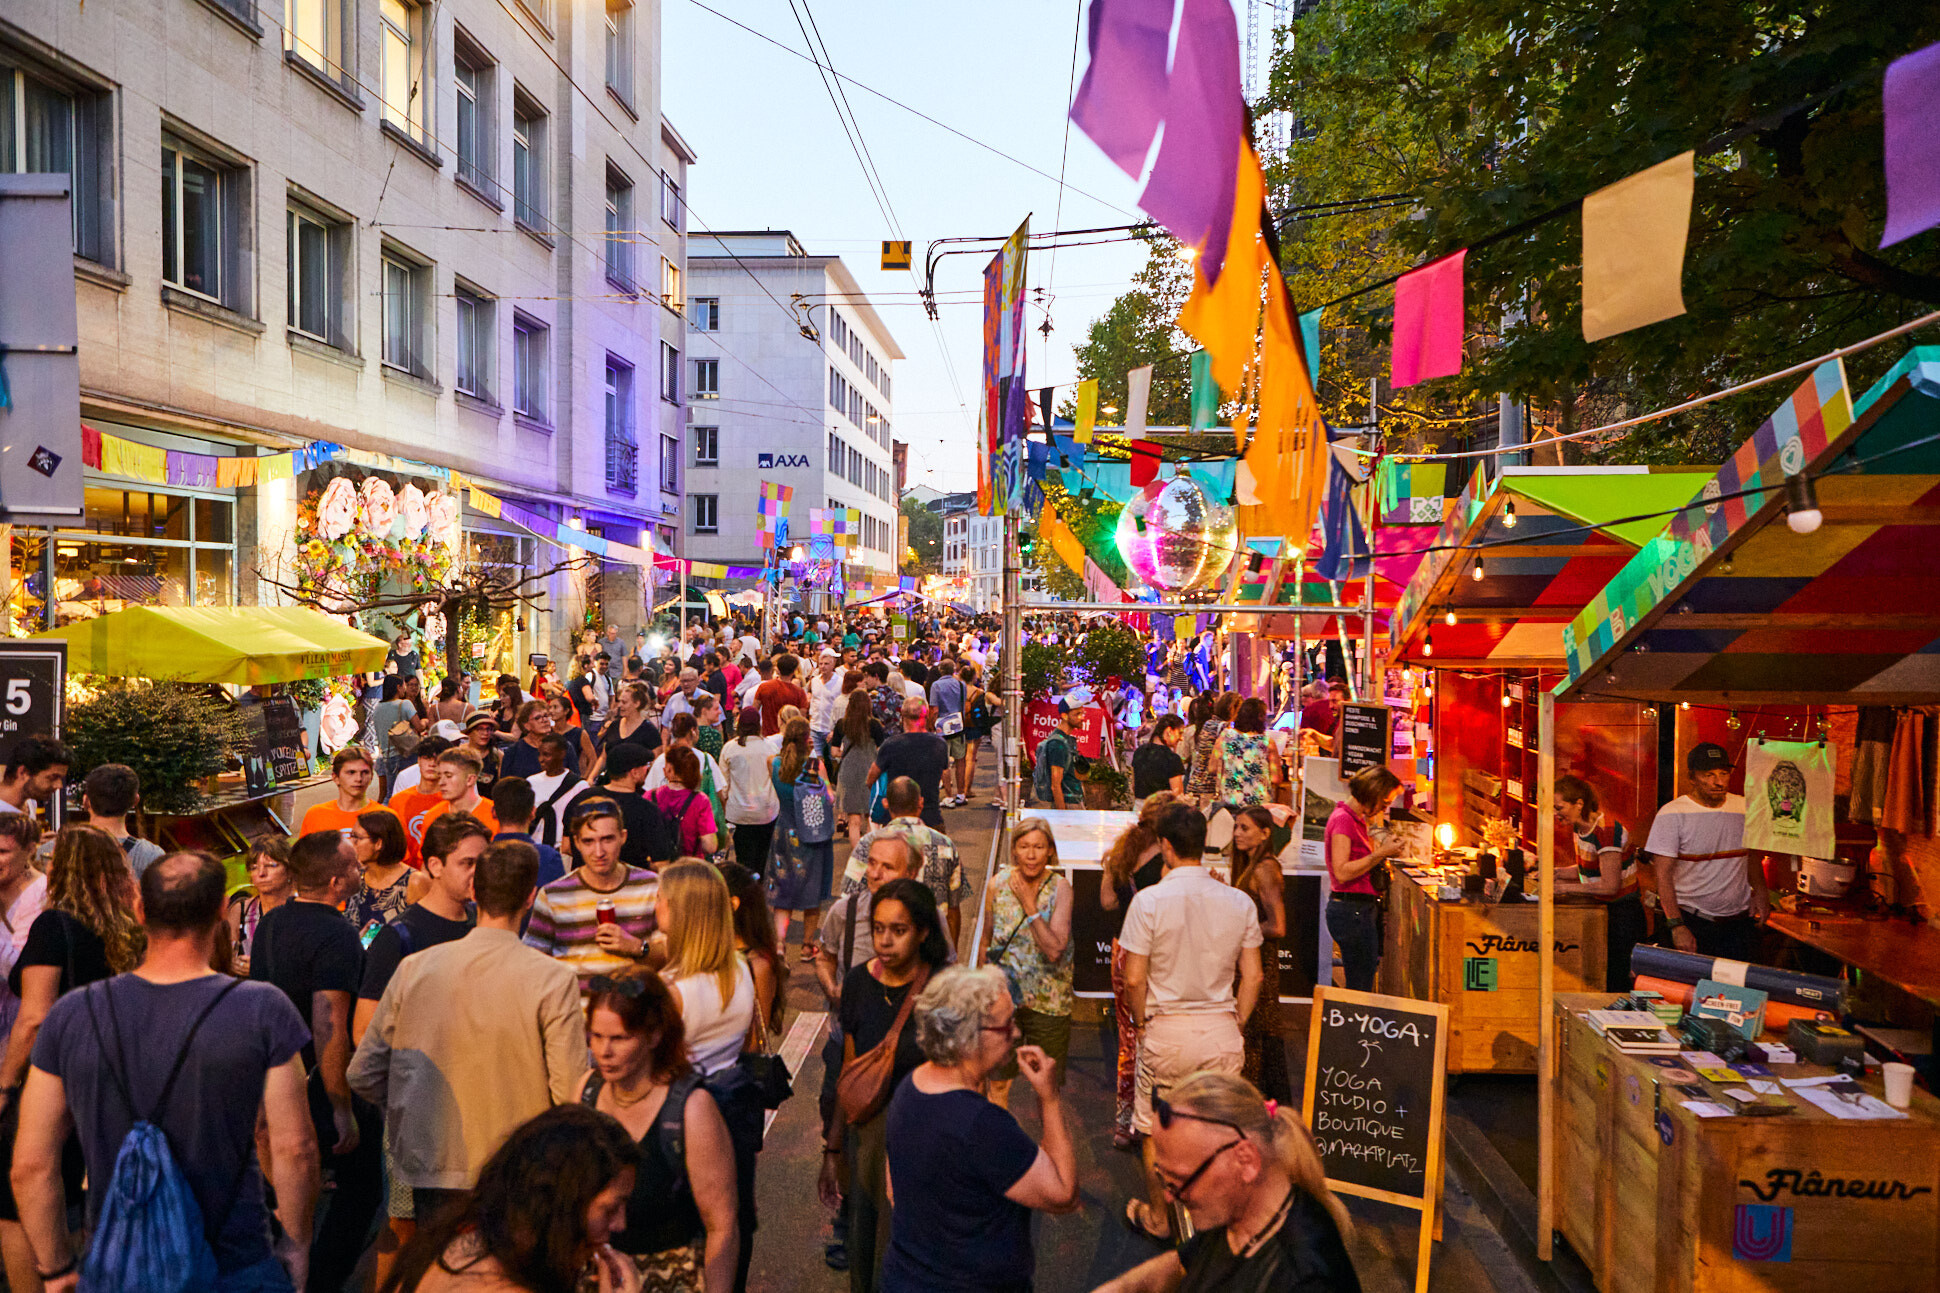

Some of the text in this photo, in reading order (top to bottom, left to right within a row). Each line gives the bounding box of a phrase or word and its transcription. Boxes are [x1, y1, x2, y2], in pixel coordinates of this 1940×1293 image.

[774, 454, 810, 467] AXA
[5, 678, 31, 715] 5
[3, 719, 18, 731] Gin
[1466, 935, 1579, 955] Flâner
[1322, 1066, 1382, 1091] YOGA
[1320, 1090, 1387, 1114] STUDIO
[1318, 1111, 1405, 1139] BOUTIQUE
[1739, 1169, 1931, 1201] Flâneur
